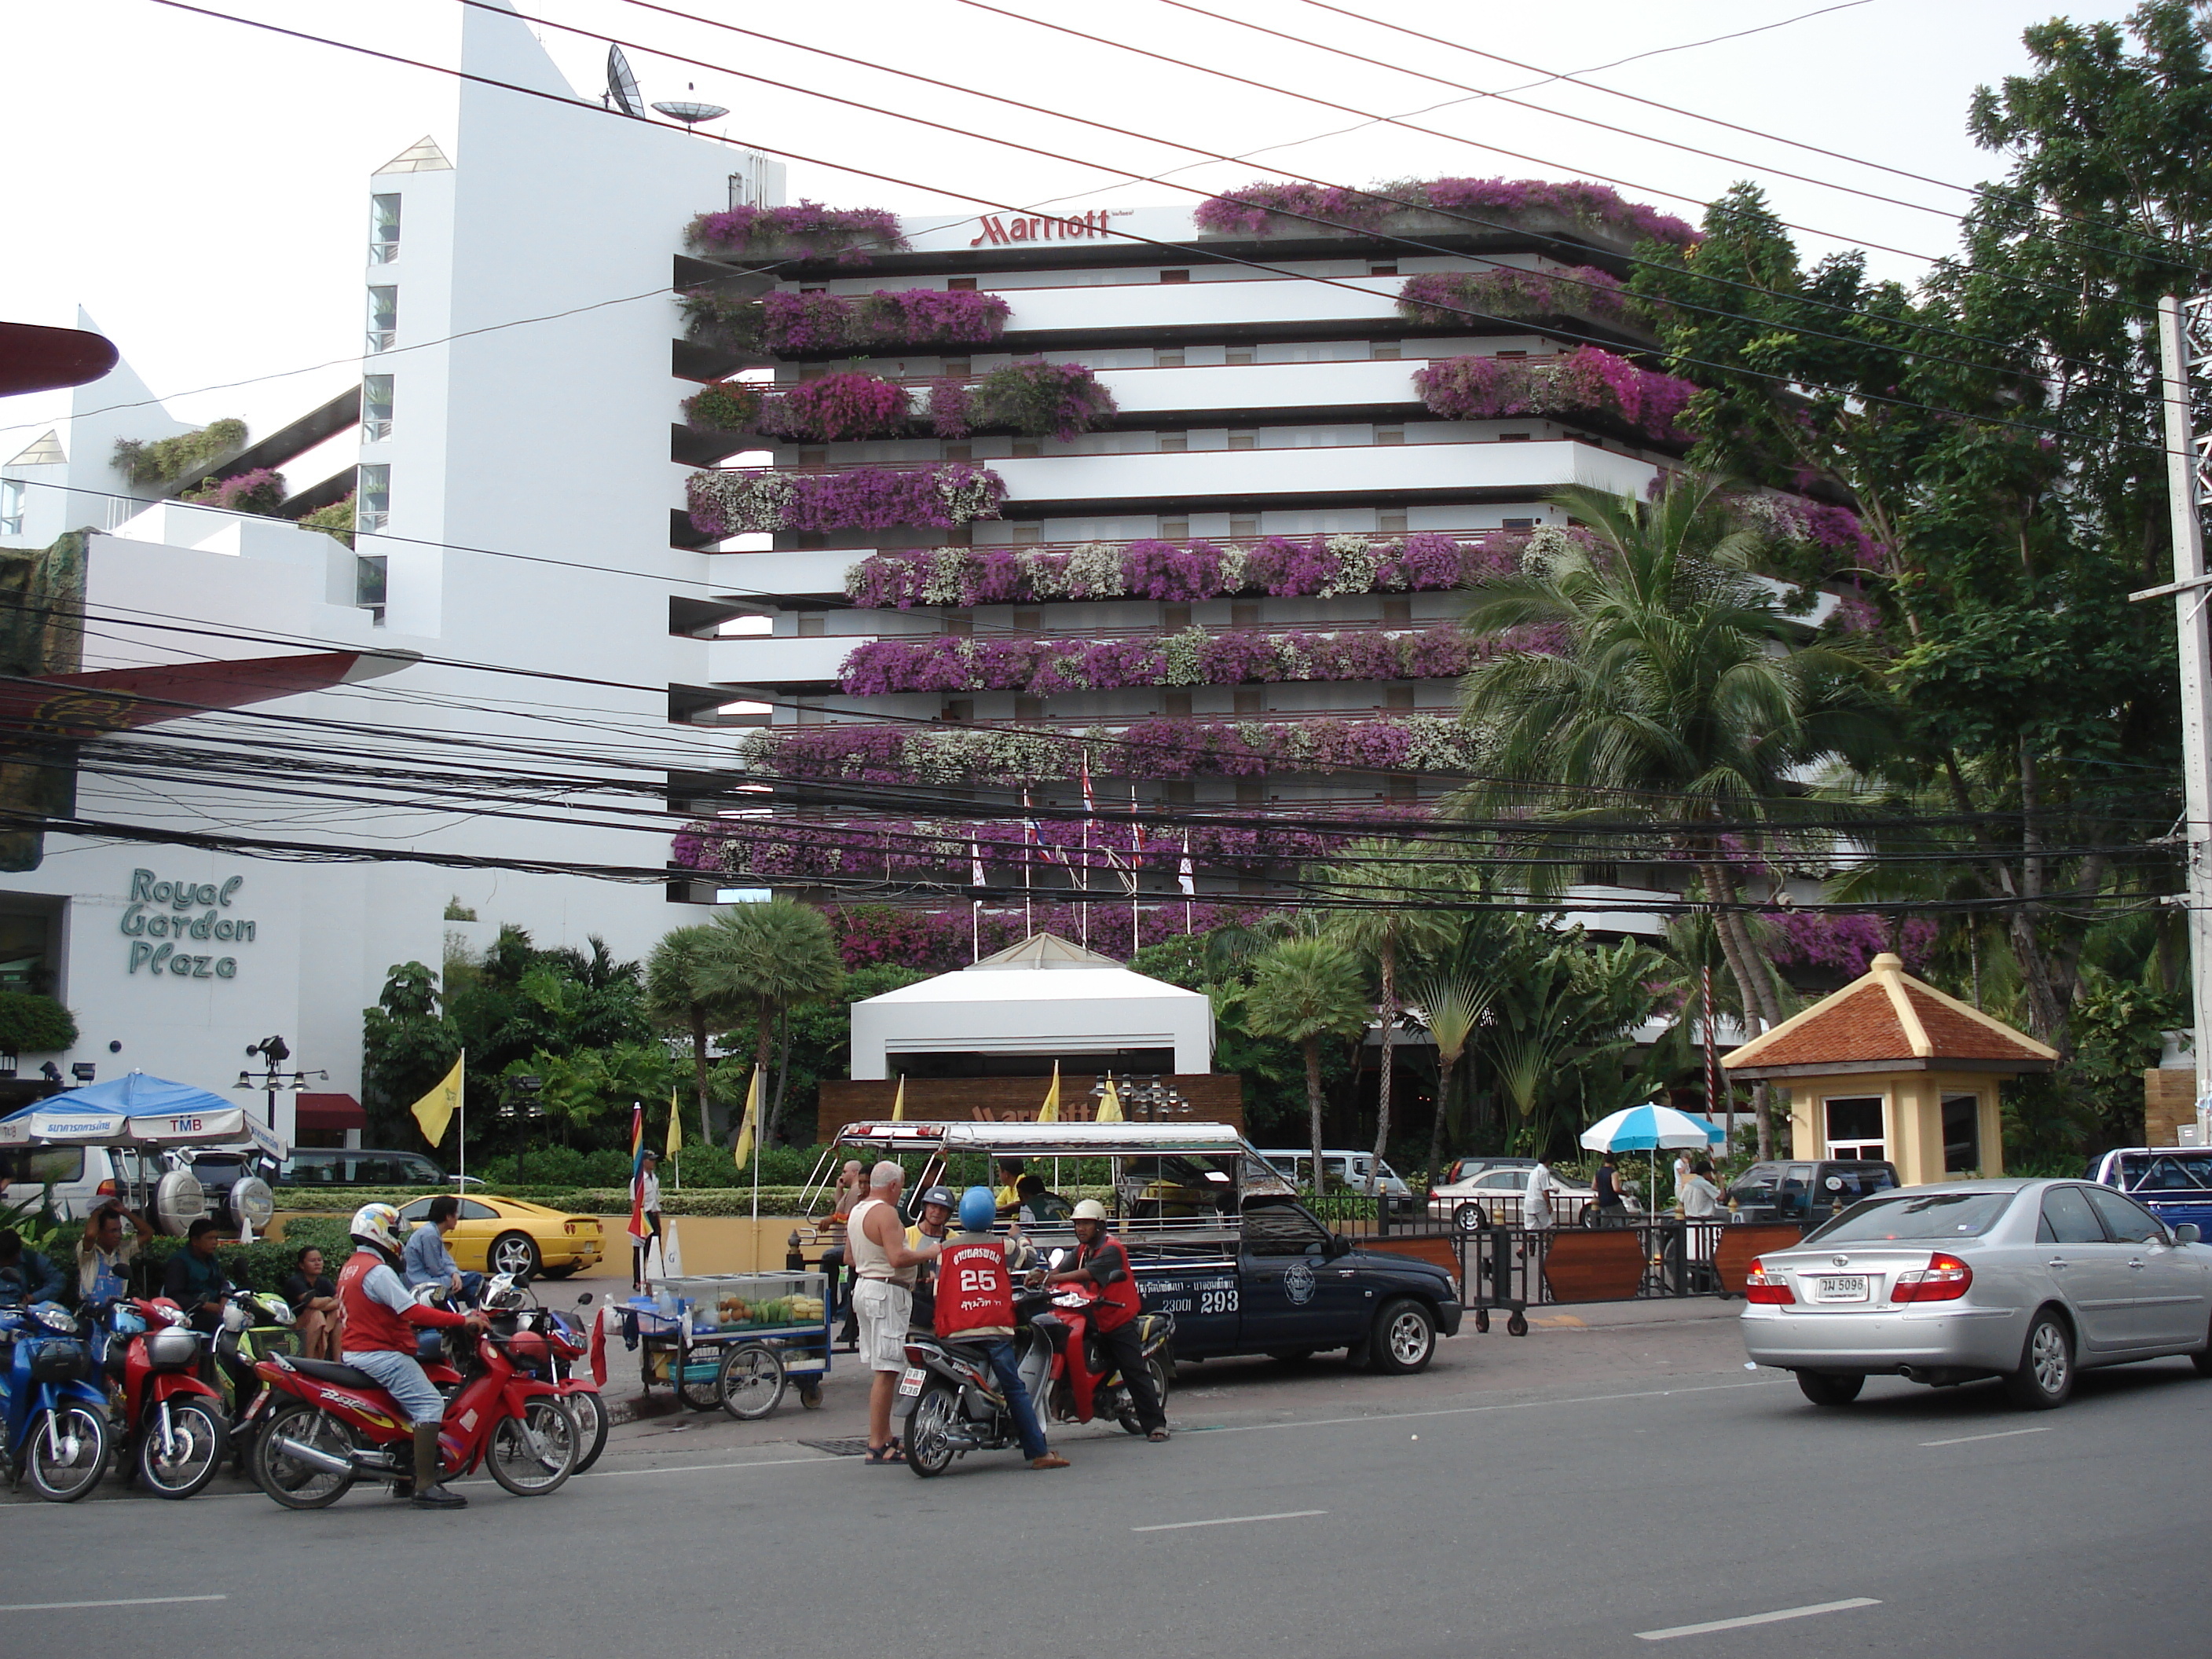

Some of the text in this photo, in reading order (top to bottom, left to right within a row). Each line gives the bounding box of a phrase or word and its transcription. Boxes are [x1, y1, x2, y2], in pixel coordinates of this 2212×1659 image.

[970, 209, 1110, 247] Marriott
[131, 868, 244, 910] Royal
[121, 903, 256, 941] Garden
[130, 940, 237, 978] Plaza
[170, 1115, 202, 1132] TMB
[960, 1269, 997, 1292] 25
[1839, 1278, 1863, 1291] 5096
[1200, 1290, 1239, 1314] 293
